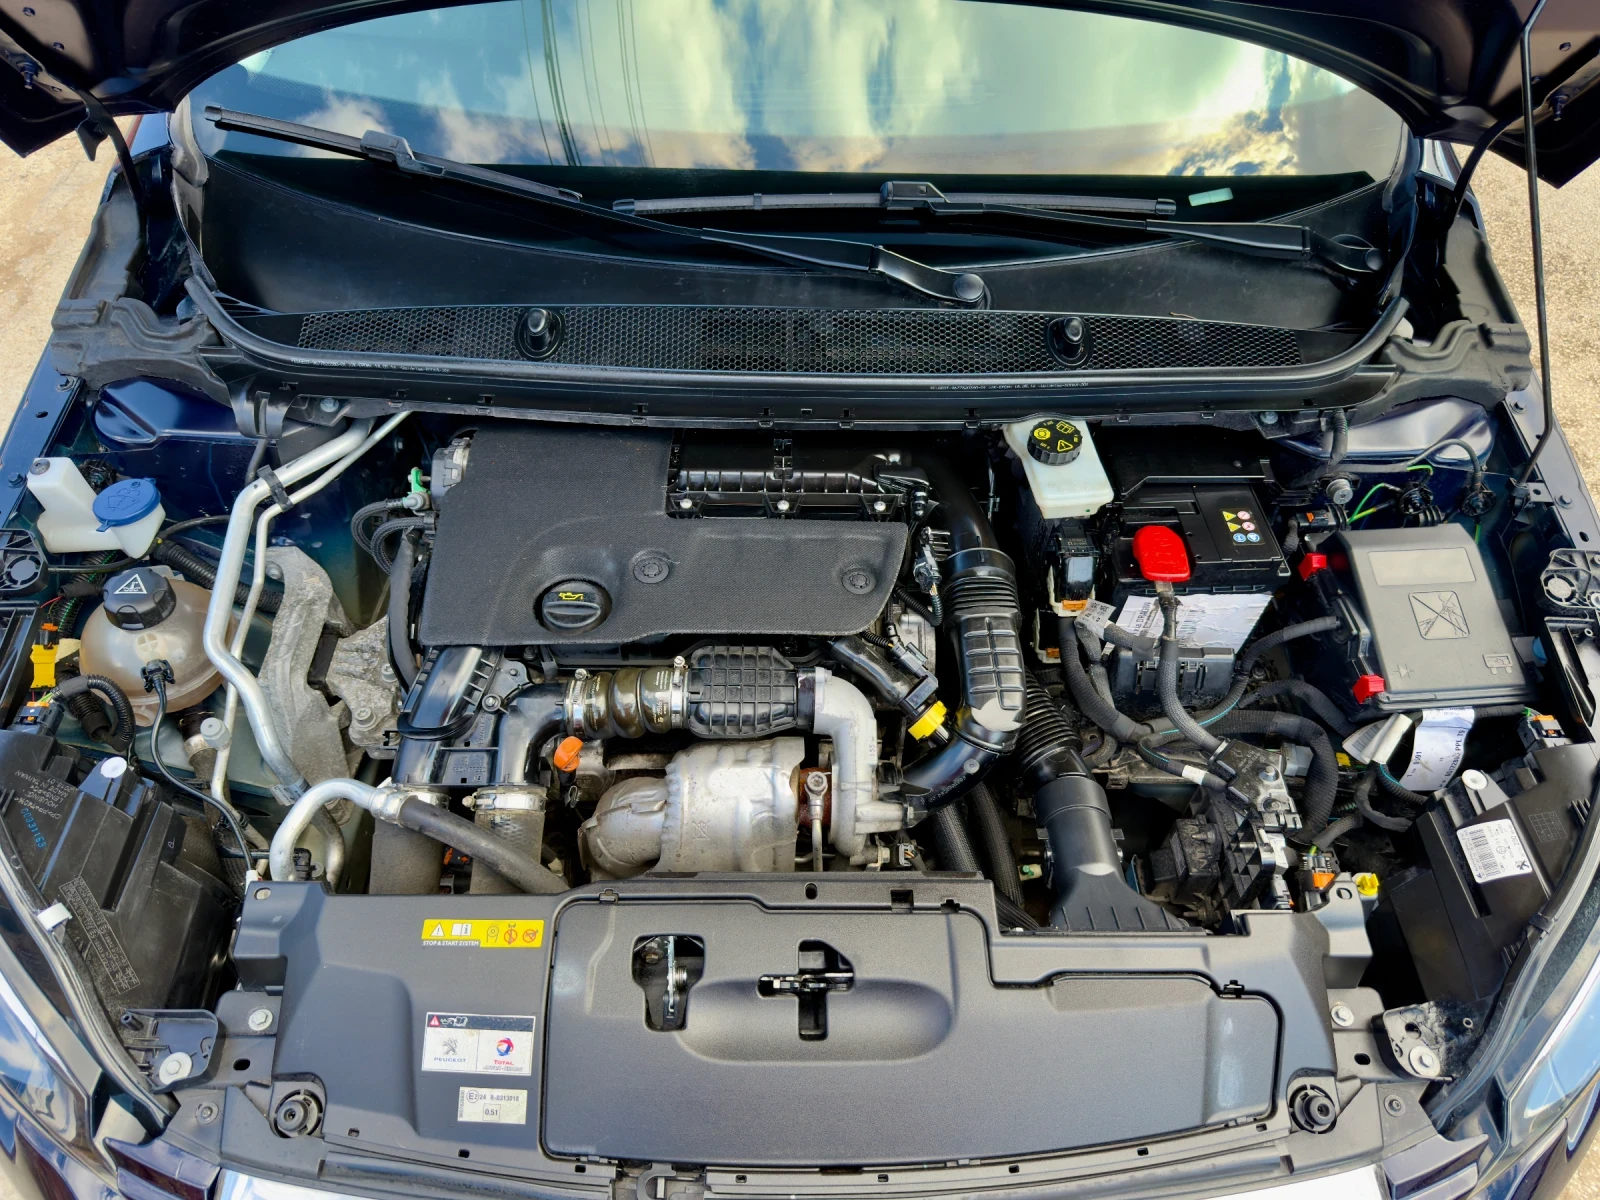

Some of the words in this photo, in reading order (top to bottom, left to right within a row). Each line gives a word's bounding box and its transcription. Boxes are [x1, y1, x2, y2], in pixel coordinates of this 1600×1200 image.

[15, 770, 40, 785] TAIWAN
[40, 781, 49, 789] IN
[48, 785, 69, 798] MADE
[484, 1108, 498, 1116] 0.51
